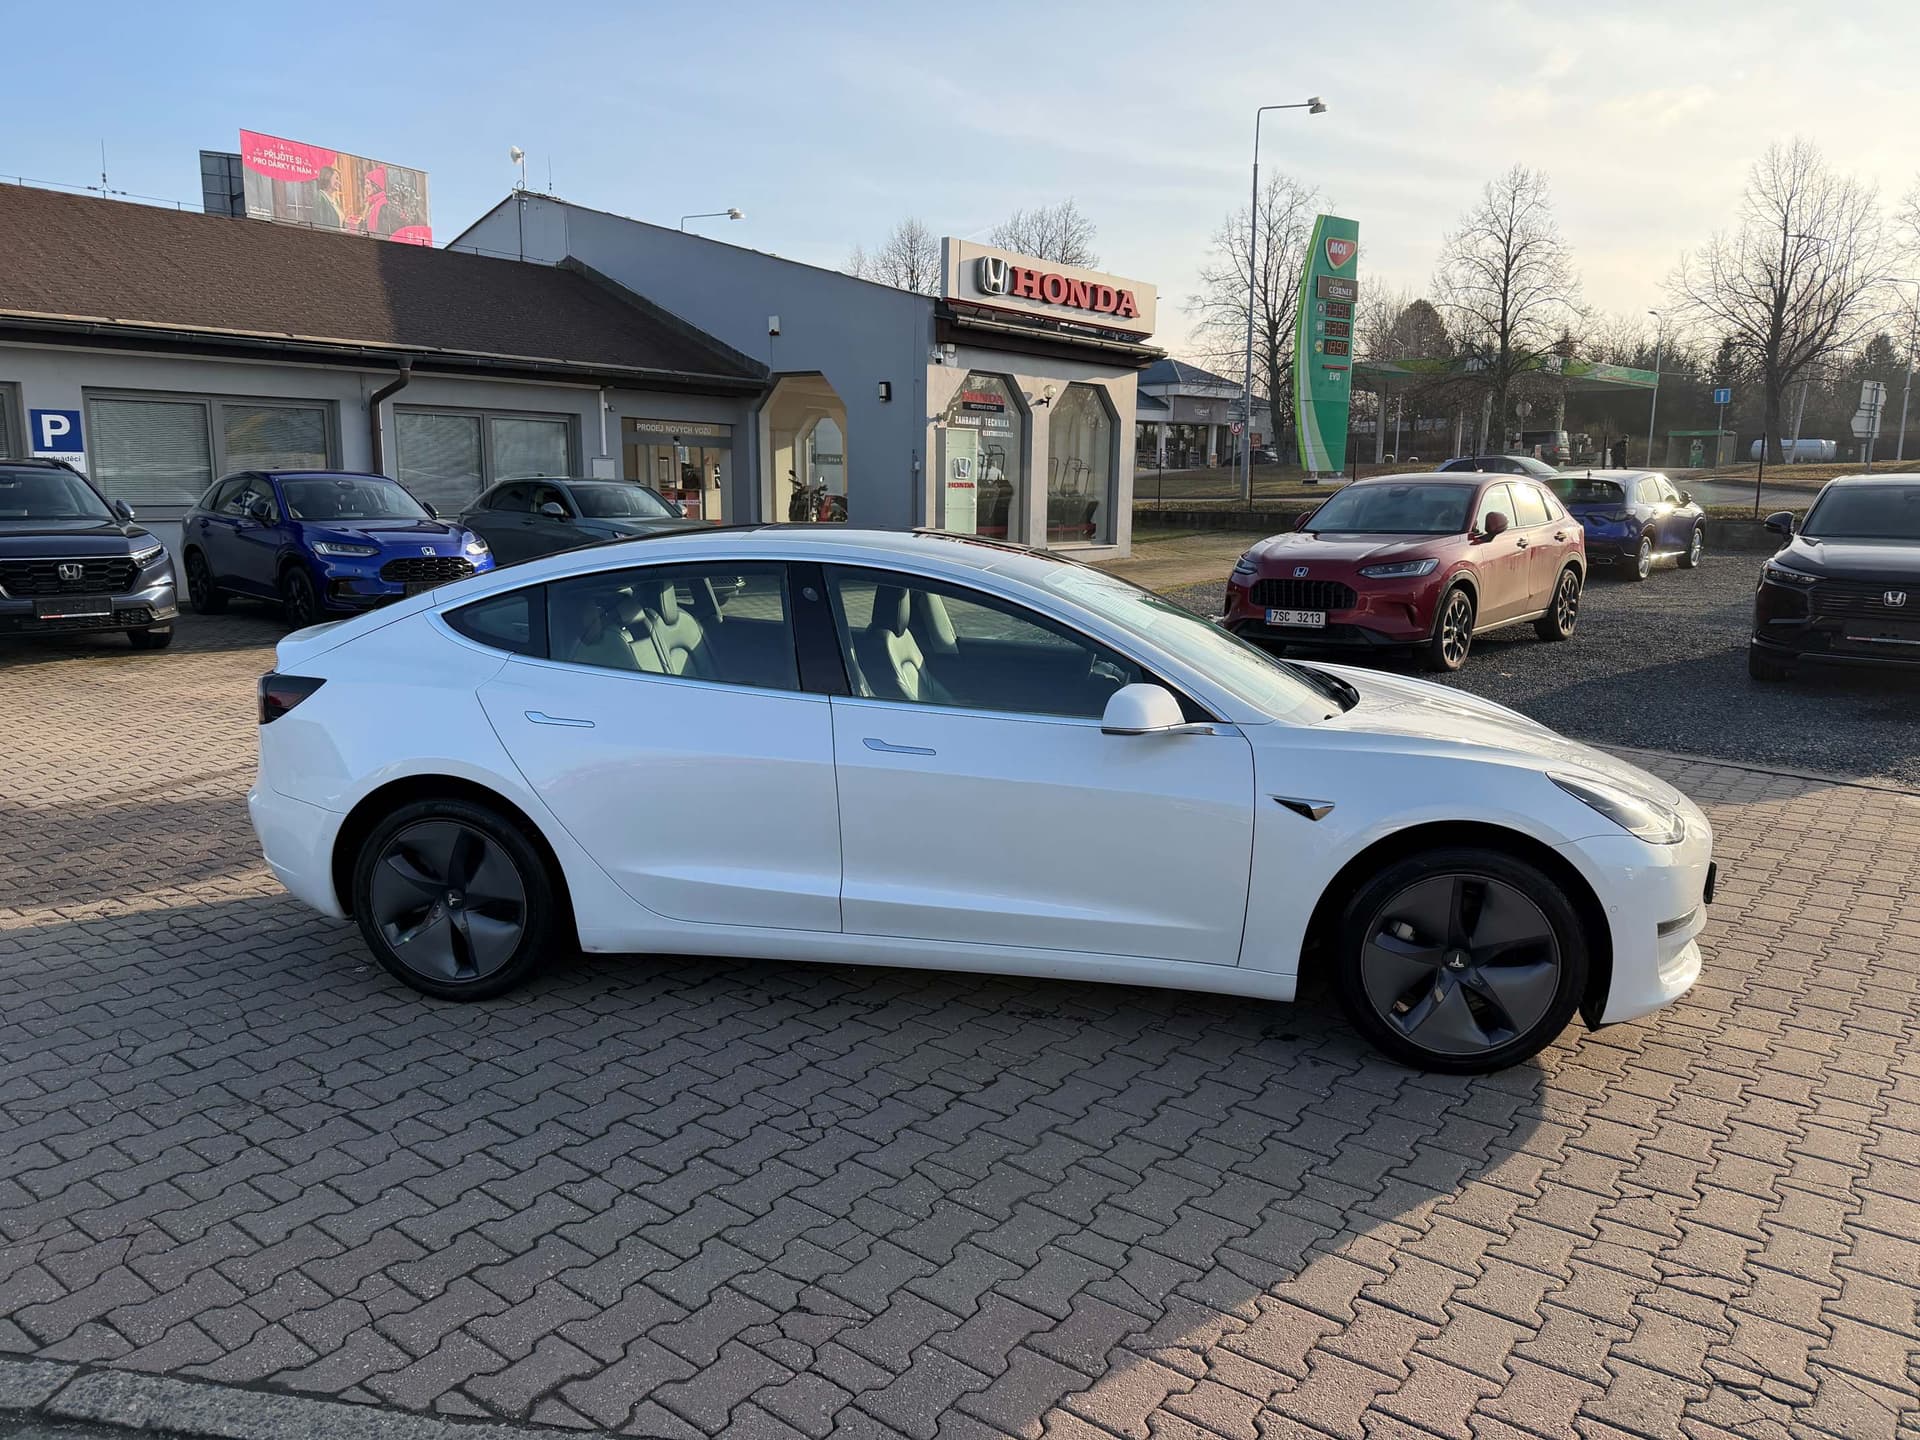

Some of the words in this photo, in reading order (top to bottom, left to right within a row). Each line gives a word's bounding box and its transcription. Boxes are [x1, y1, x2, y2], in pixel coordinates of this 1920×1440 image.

[253, 156, 267, 165] PRO
[268, 158, 290, 170] DÁRKY
[297, 165, 312, 175] NÁM
[1330, 241, 1348, 255] MOL
[1010, 266, 1141, 318] HONDA
[636, 423, 664, 432] PRODEJ
[955, 415, 982, 426] ZAHRADNÍ
[985, 418, 1010, 428] TECHNIKA
[41, 414, 71, 448] P
[947, 481, 975, 489] HONDA
[1273, 610, 1290, 622] 7SC
[1297, 612, 1321, 624] 3213
